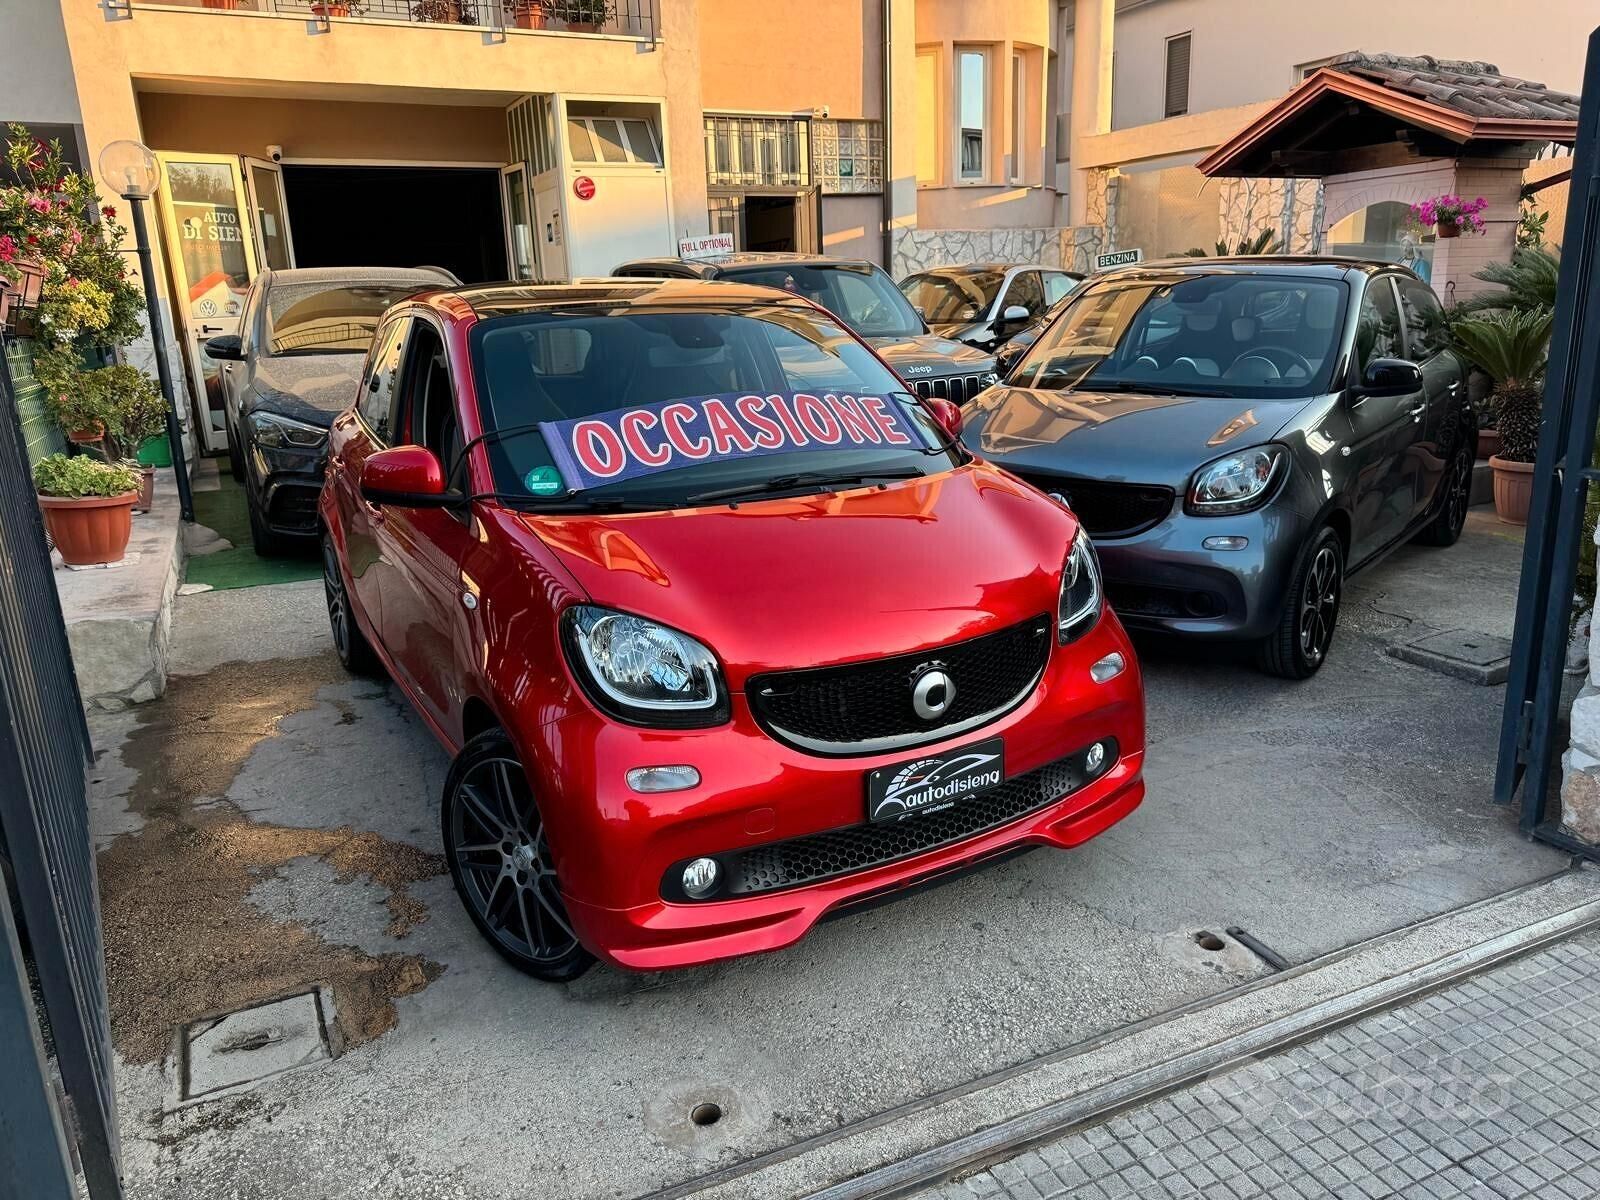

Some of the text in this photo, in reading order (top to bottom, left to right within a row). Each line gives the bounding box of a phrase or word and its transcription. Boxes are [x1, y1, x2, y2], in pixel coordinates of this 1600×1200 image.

[204, 211, 236, 224] AUTO
[681, 237, 732, 253] FULL OPTIONAL
[1100, 252, 1136, 266] BENZINA
[908, 365, 932, 374] Jeep
[572, 393, 911, 478] OCCASIONE
